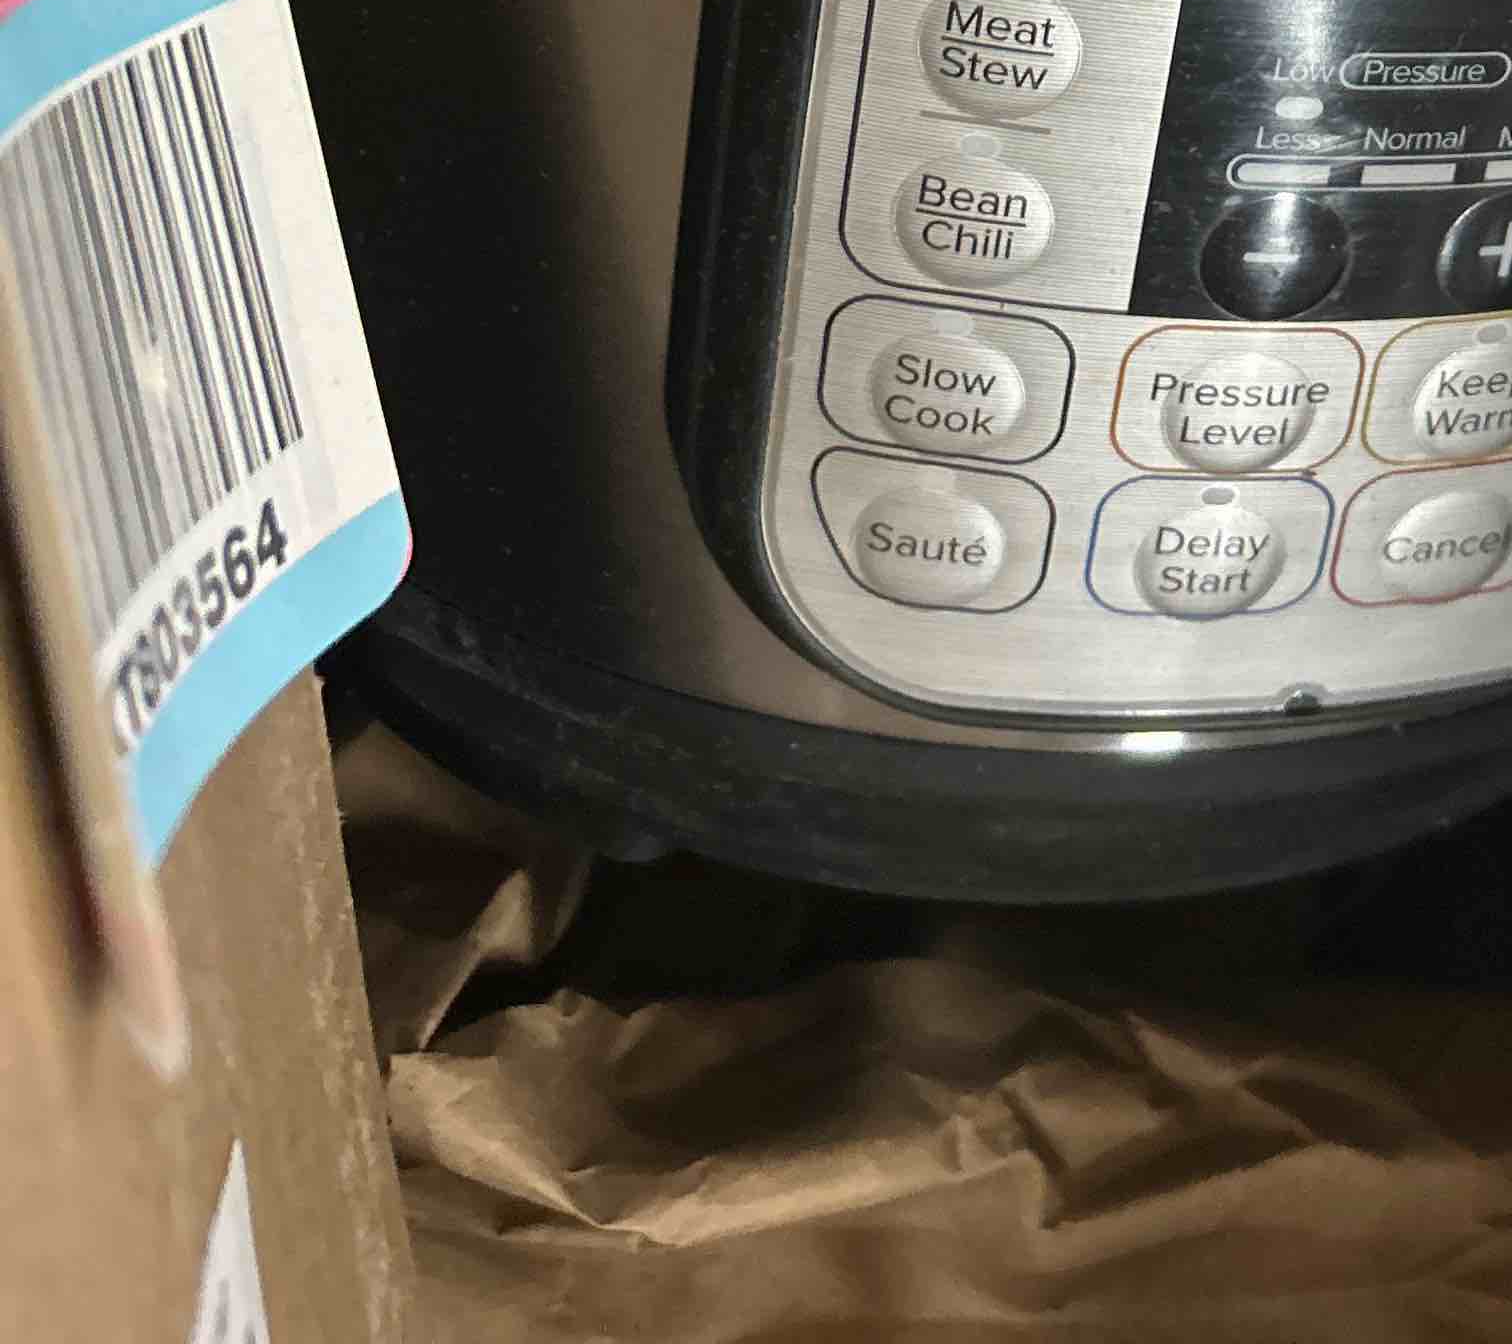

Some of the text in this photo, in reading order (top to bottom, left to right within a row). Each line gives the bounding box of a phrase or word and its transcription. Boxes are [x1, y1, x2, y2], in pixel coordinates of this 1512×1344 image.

[945, 0, 1056, 48] Meat
[939, 46, 1048, 90] Stew
[1273, 57, 1334, 83] Low
[1362, 58, 1486, 83] Pressure
[1255, 126, 1322, 151] Less
[1363, 125, 1467, 151] Normal
[917, 174, 1028, 220] Bean
[921, 219, 1014, 260] Chili
[895, 353, 997, 397] Slow
[1150, 373, 1331, 408] Pressure
[884, 394, 996, 436] Cook
[1180, 415, 1290, 447] Level
[865, 521, 989, 567] Sauté
[1154, 526, 1273, 563] Delay
[1383, 523, 1512, 564] Cancel
[1159, 565, 1252, 595] Start
